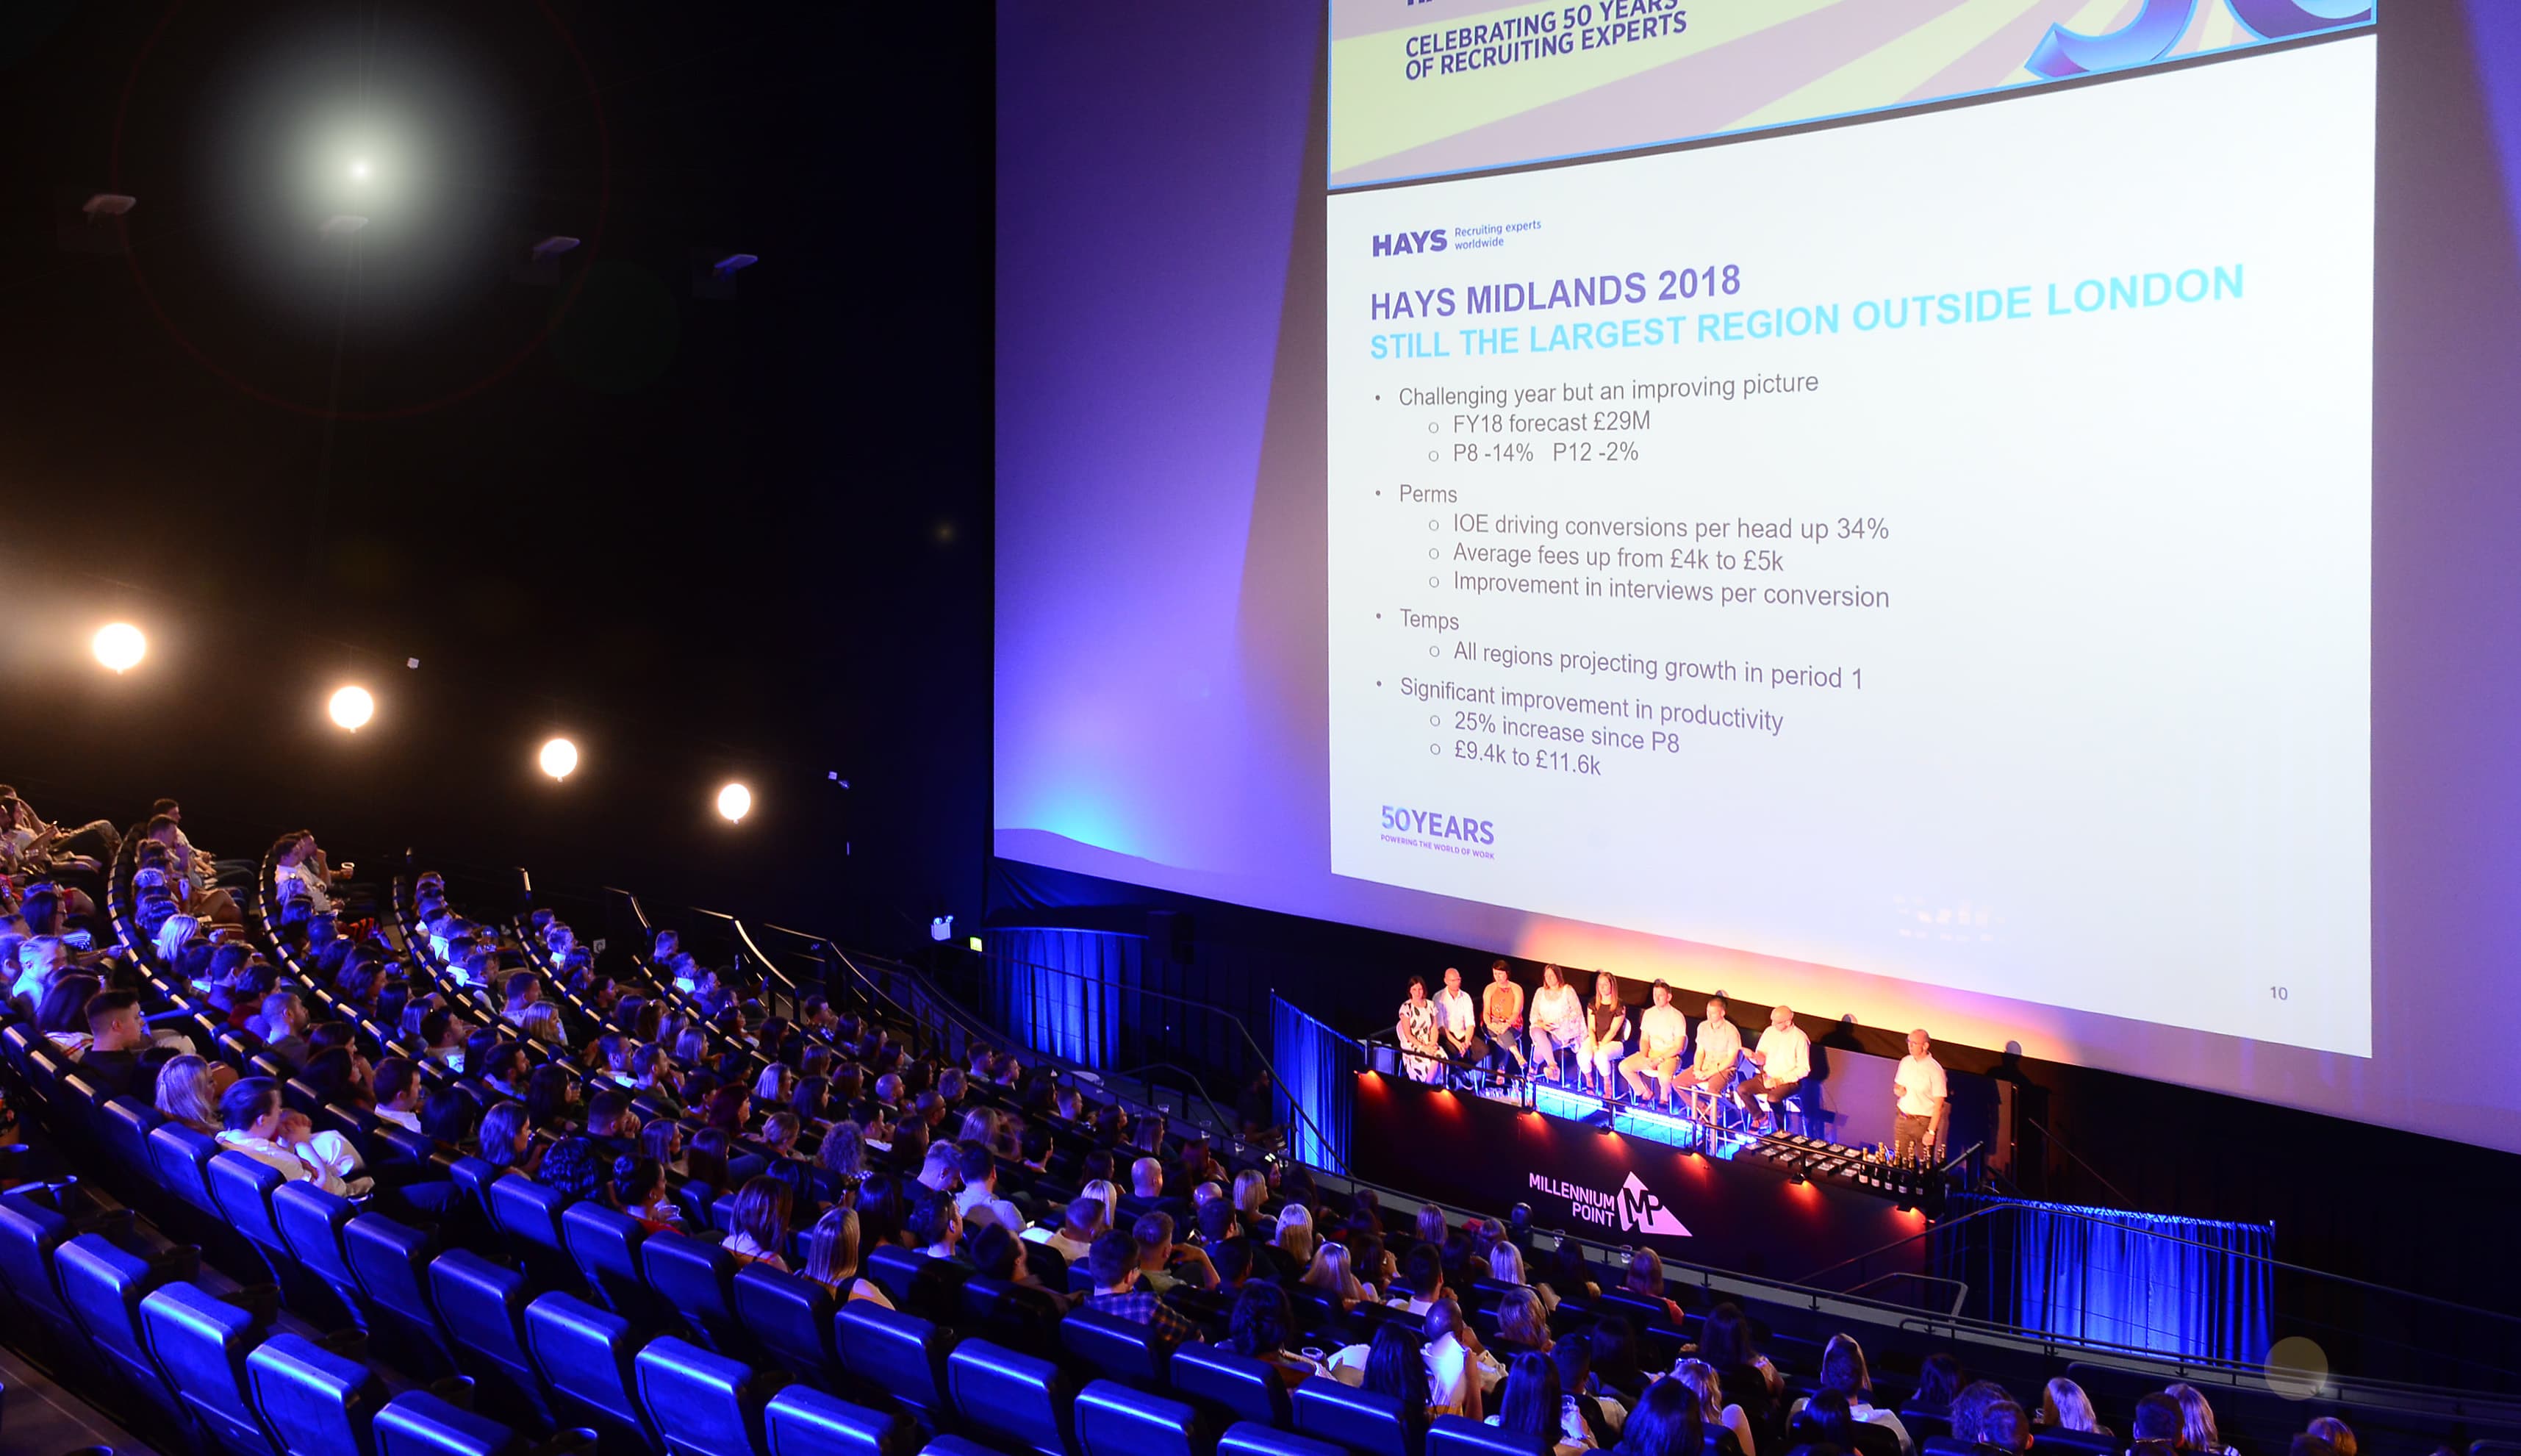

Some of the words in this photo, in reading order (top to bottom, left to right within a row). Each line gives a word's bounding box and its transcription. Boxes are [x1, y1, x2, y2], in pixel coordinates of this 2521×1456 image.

[1405, 57, 1434, 80] OF
[1441, 32, 1574, 75] RECRUITING
[1582, 10, 1687, 50] EXPERTS
[1406, 14, 1556, 57] CELEBRATING
[1563, 4, 1592, 29] 50
[1373, 229, 1447, 257] HAYS
[1454, 224, 1502, 237] Recruiting
[1505, 220, 1541, 233] experts
[1455, 237, 1504, 250] worldwide
[1371, 331, 1450, 360] STILL
[1460, 327, 1519, 356] THE
[1531, 315, 1688, 353] LARGEST
[1698, 304, 1840, 343] REGION
[1852, 286, 2031, 331] OUTSIDE
[2048, 263, 2244, 316] LONDON
[1372, 287, 1455, 321] HAYS
[1468, 272, 1646, 315] MIDLANDS
[1658, 265, 1740, 301] 2018
[1399, 385, 1507, 409] Challenging
[1514, 387, 1557, 409] year
[1563, 382, 1594, 402] but
[1600, 384, 1624, 401] an
[1632, 376, 1735, 404] improving
[1744, 372, 1819, 401] picture
[1454, 414, 1503, 434] FY18
[1509, 412, 1588, 433] forecast
[1593, 409, 1650, 431] £29M
[1454, 442, 1478, 462] P8
[1485, 442, 1534, 462] -14%
[1553, 442, 1592, 462] P12
[1599, 441, 1639, 462] -2%
[1399, 484, 1457, 503] Perms
[1455, 513, 1489, 533] IOE
[1496, 514, 1558, 540] driving
[1566, 519, 1688, 537] conversions
[1696, 522, 1731, 543] per
[1738, 517, 1792, 539] head
[1801, 523, 1829, 545] up
[1837, 517, 1889, 539] 34%
[1454, 542, 1532, 568] Average
[1538, 545, 1579, 566] fees
[1587, 551, 1611, 571] up
[1617, 547, 1663, 569] from
[1671, 548, 1710, 570] £4k
[1716, 551, 1736, 570] to
[1743, 549, 1784, 572] £5k
[1455, 570, 1579, 596] Improvement
[1586, 574, 1602, 597] in
[1610, 578, 1714, 602] interviews
[1722, 586, 1757, 608] per
[1764, 585, 1890, 609] conversion
[1400, 609, 1460, 635] Temps
[1454, 641, 1477, 661] All
[1483, 645, 1553, 669] regions
[1560, 650, 1658, 681] projecting
[1665, 659, 1737, 682] growth
[1745, 661, 1763, 684] in
[1772, 664, 1842, 689] period
[1852, 667, 1861, 690] 1
[1400, 676, 1496, 705] Significant
[1502, 686, 1629, 718] improvement
[1636, 697, 1653, 720] in
[1660, 703, 1784, 737] productivity
[1455, 710, 1496, 734] 25%
[1502, 715, 1585, 744] increase
[1591, 725, 1645, 750] since
[1652, 731, 1680, 753] P8
[1455, 739, 1507, 764] £9.4k
[1512, 747, 1530, 767] to
[1536, 749, 1602, 776] £11.6k
[1380, 834, 1418, 847] POWERING
[1419, 841, 1432, 850] THE
[1433, 843, 1460, 854] WORLD
[1461, 847, 1471, 856] OF
[1472, 849, 1495, 860] WORK
[2270, 986, 2288, 1000] 10
[1529, 1172, 1615, 1212] MILLENNIUM
[1572, 1201, 1615, 1227] POINT
